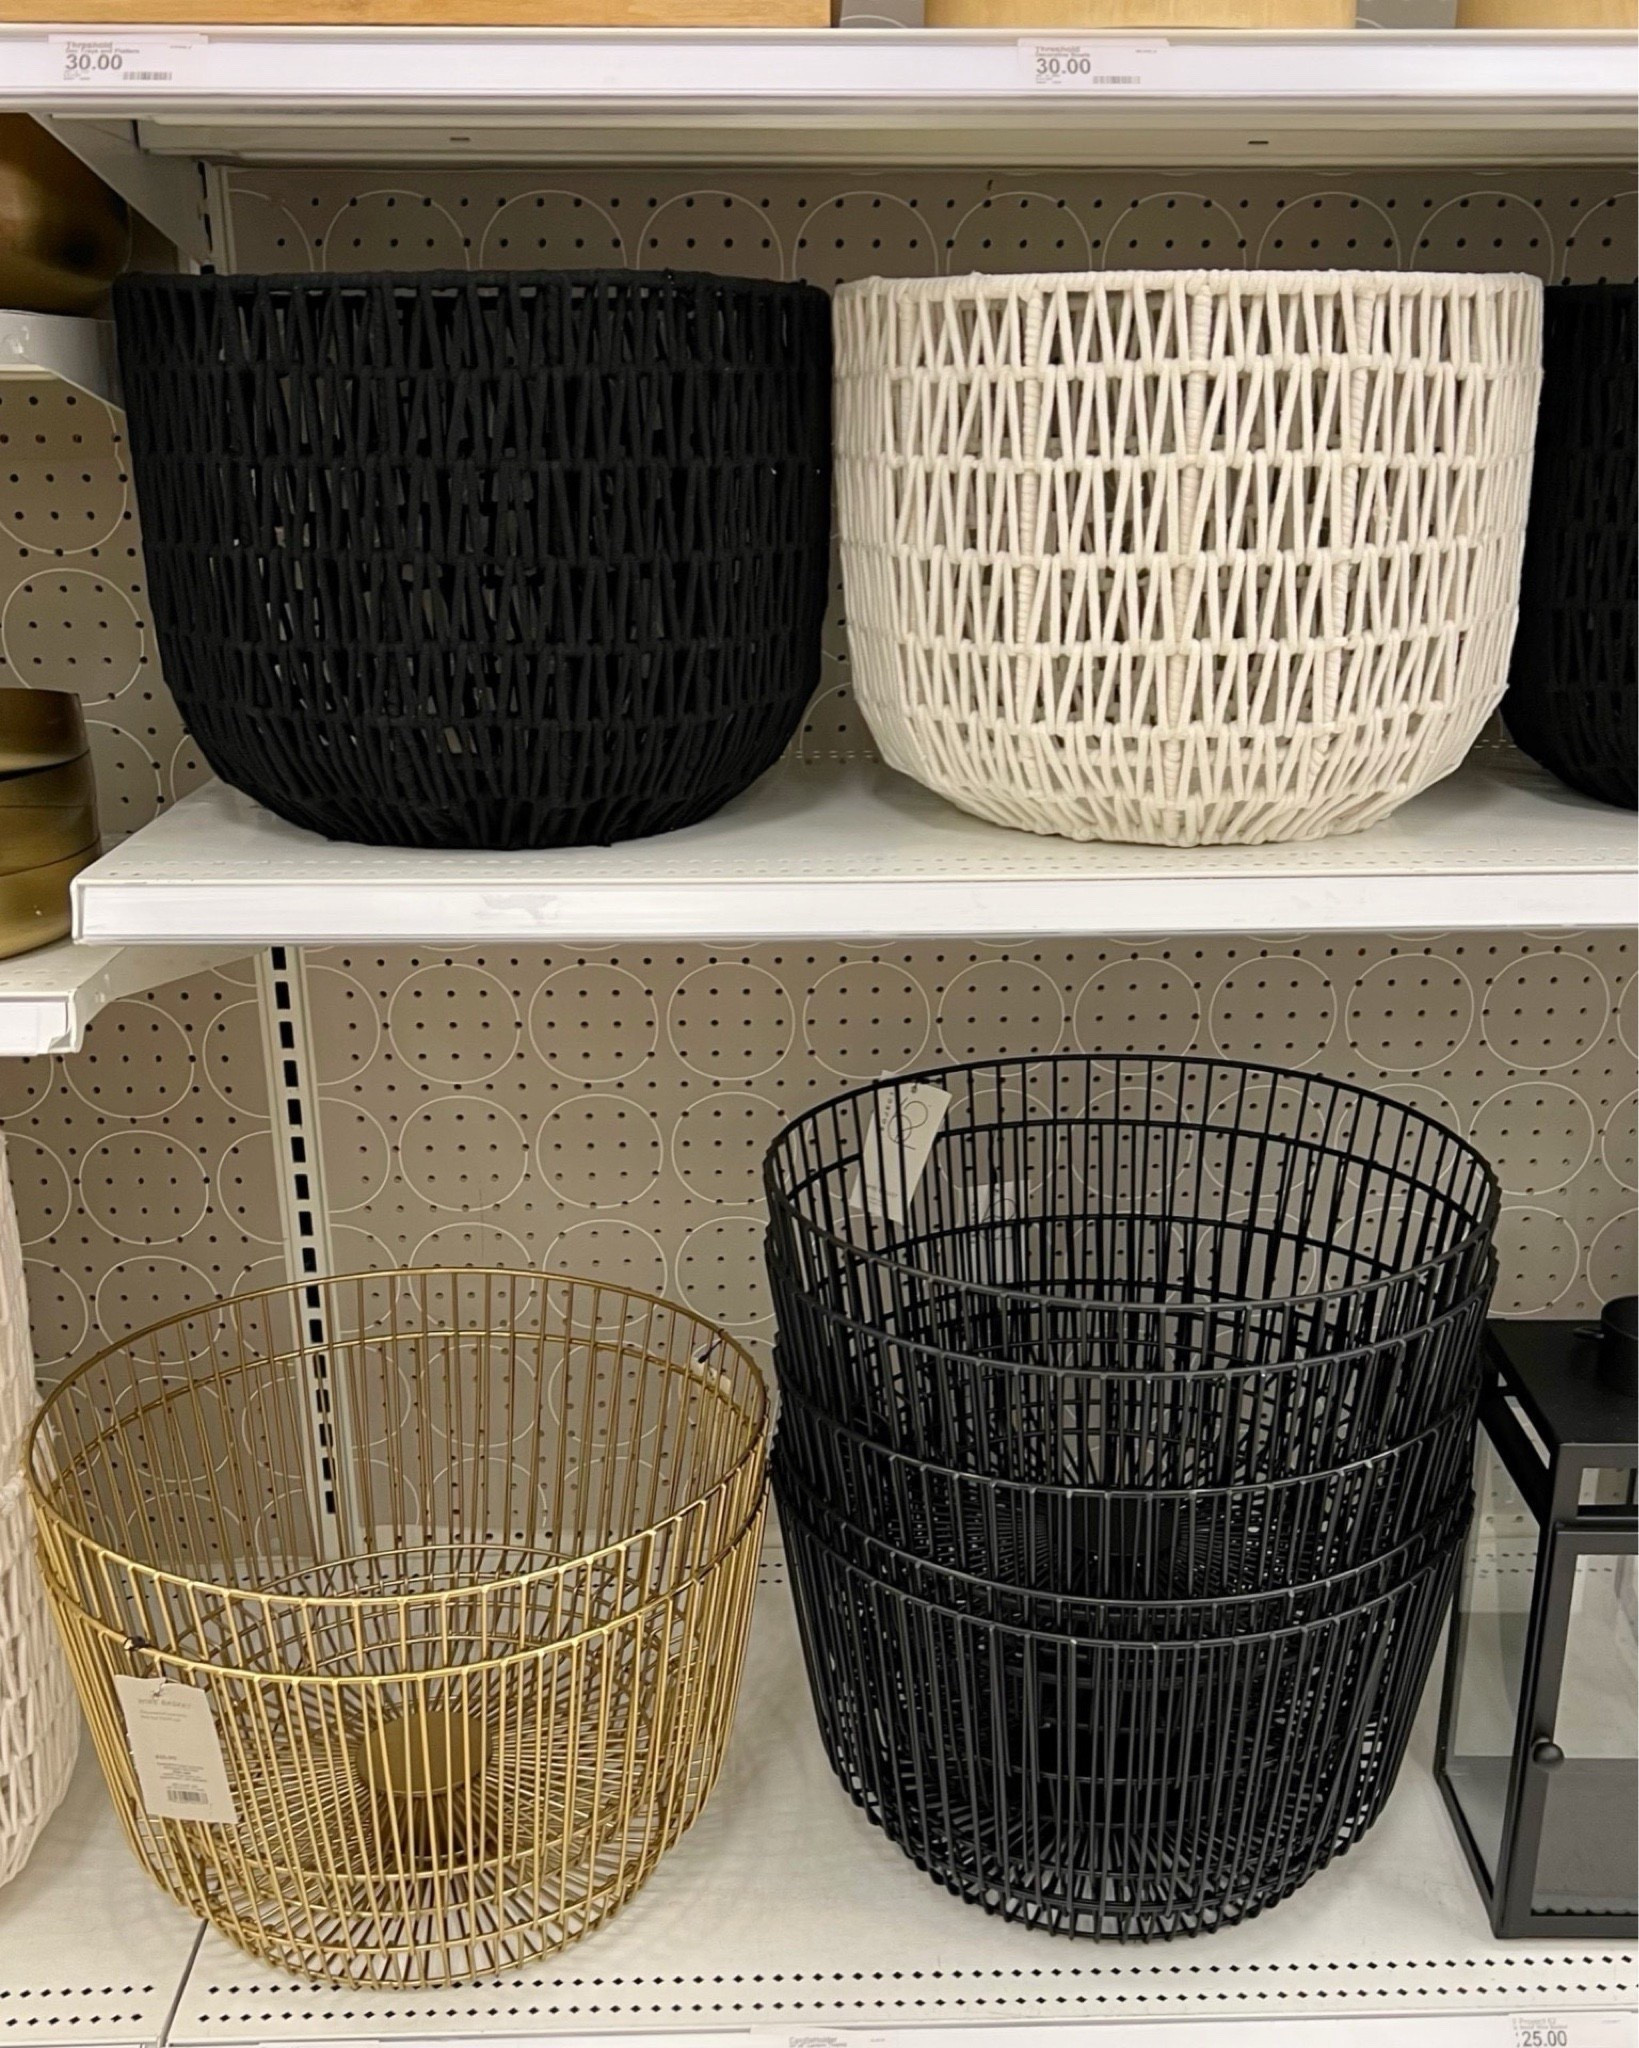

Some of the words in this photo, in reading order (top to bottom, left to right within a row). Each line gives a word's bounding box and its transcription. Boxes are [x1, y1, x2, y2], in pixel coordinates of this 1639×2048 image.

[65, 54, 123, 70] 30.00
[1036, 58, 1091, 74] 30.00
[1521, 2030, 1567, 2047] 25.00
